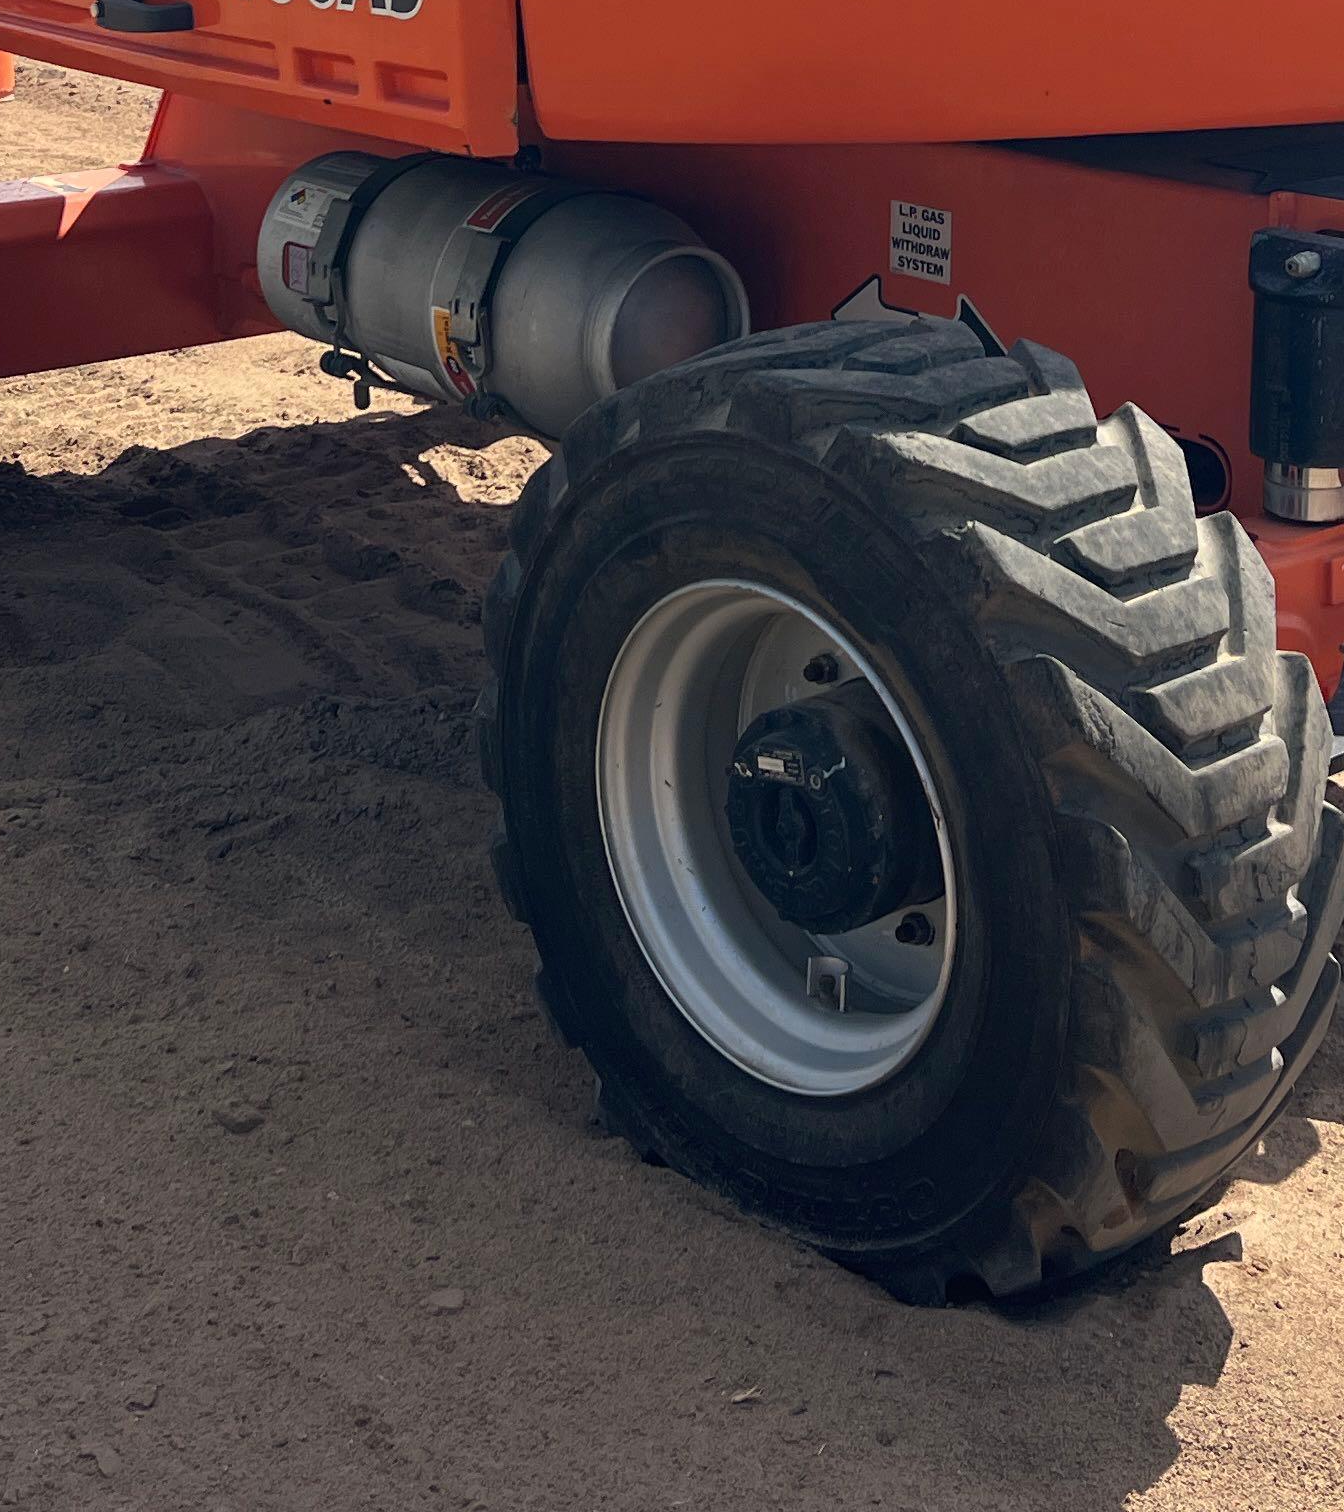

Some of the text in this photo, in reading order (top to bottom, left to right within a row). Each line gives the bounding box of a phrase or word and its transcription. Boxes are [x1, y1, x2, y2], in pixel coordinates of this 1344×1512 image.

[921, 209, 945, 225] GAS
[902, 221, 941, 241] LIQUID
[891, 236, 950, 261] WITHDRAW
[897, 255, 944, 277] SYSTEM
